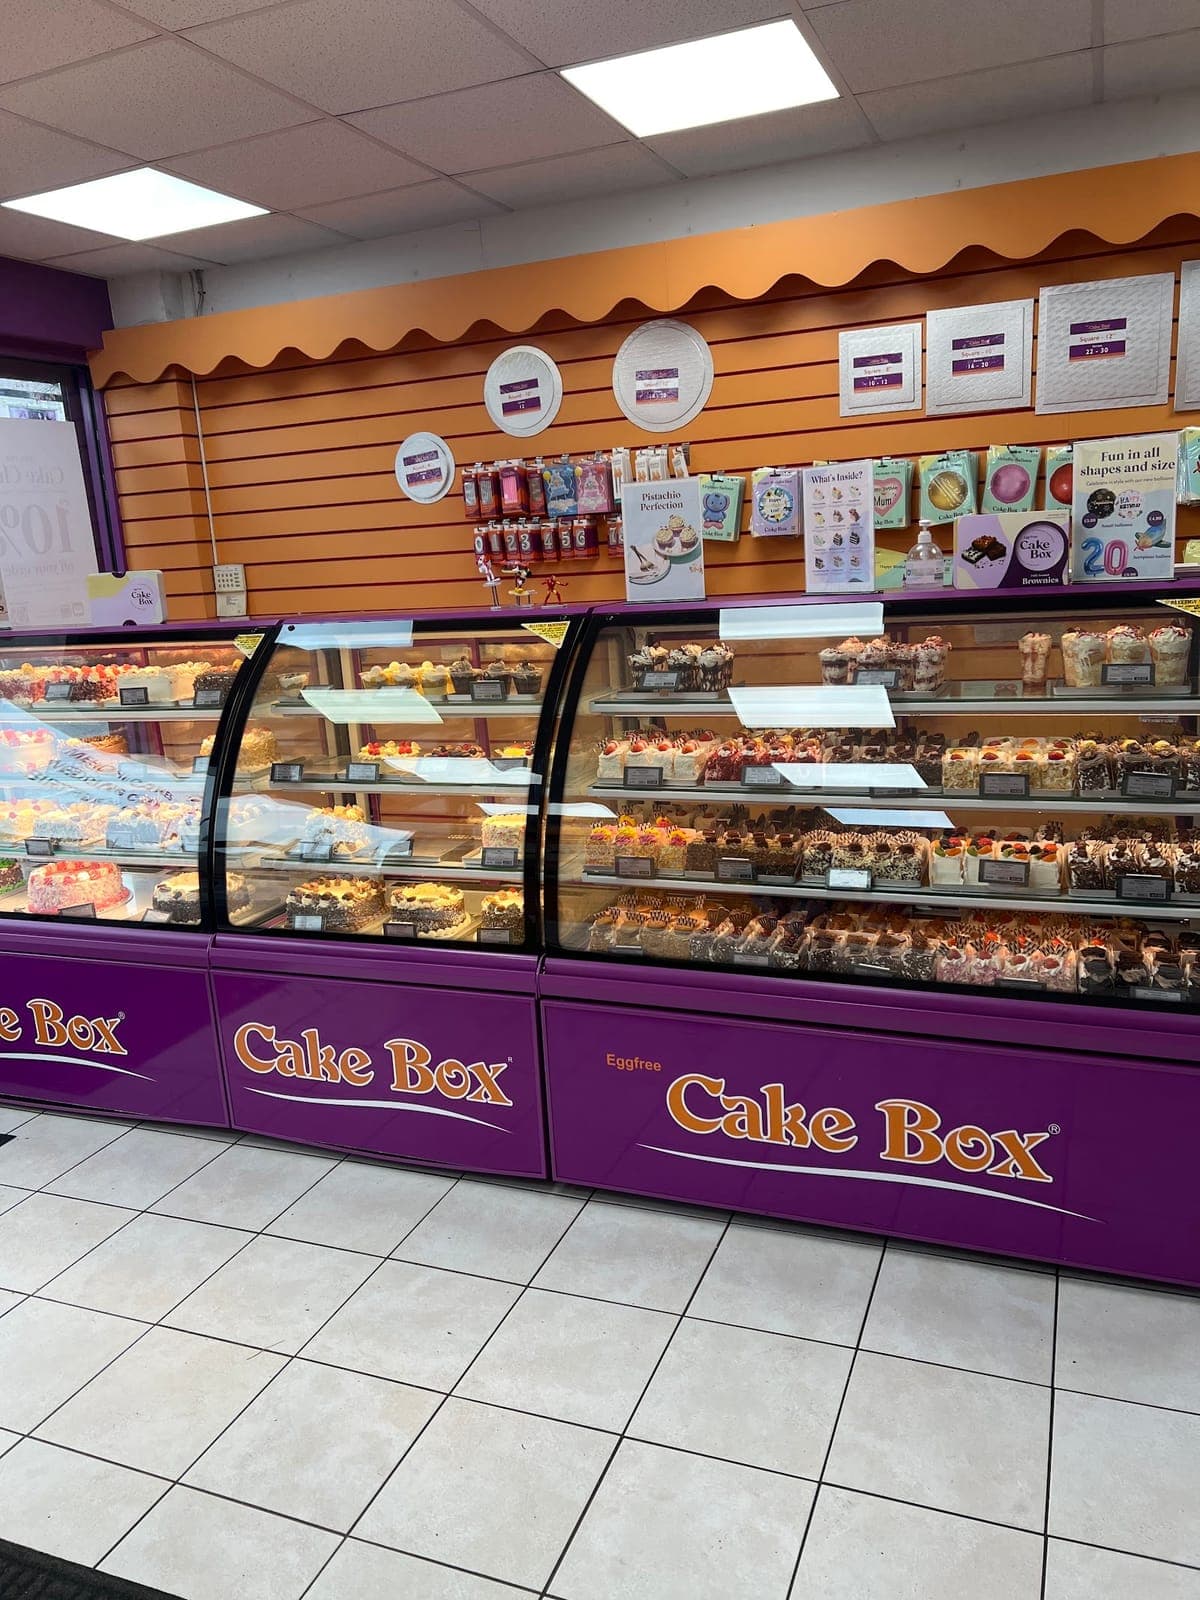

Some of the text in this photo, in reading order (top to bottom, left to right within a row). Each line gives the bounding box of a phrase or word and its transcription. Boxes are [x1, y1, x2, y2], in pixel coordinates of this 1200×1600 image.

[1101, 447, 1160, 462] Fun in all
[1080, 459, 1175, 478] shapes and size
[811, 471, 863, 484] What's Inside?
[642, 490, 681, 501] Pistachio
[874, 496, 892, 507] Mum
[640, 502, 684, 512] Perfection
[507, 535, 516, 551] 2
[521, 533, 531, 551] 3
[561, 532, 571, 548] 5
[577, 530, 586, 546] 6
[1020, 540, 1050, 551] Cake
[1030, 550, 1052, 559] Box
[1022, 576, 1059, 585] Brownies
[131, 591, 151, 599] Cake
[26, 999, 128, 1055] Box
[234, 1022, 513, 1107] Cake Box
[606, 1053, 662, 1072] Eggfree
[666, 1072, 1054, 1184] Cake Box
